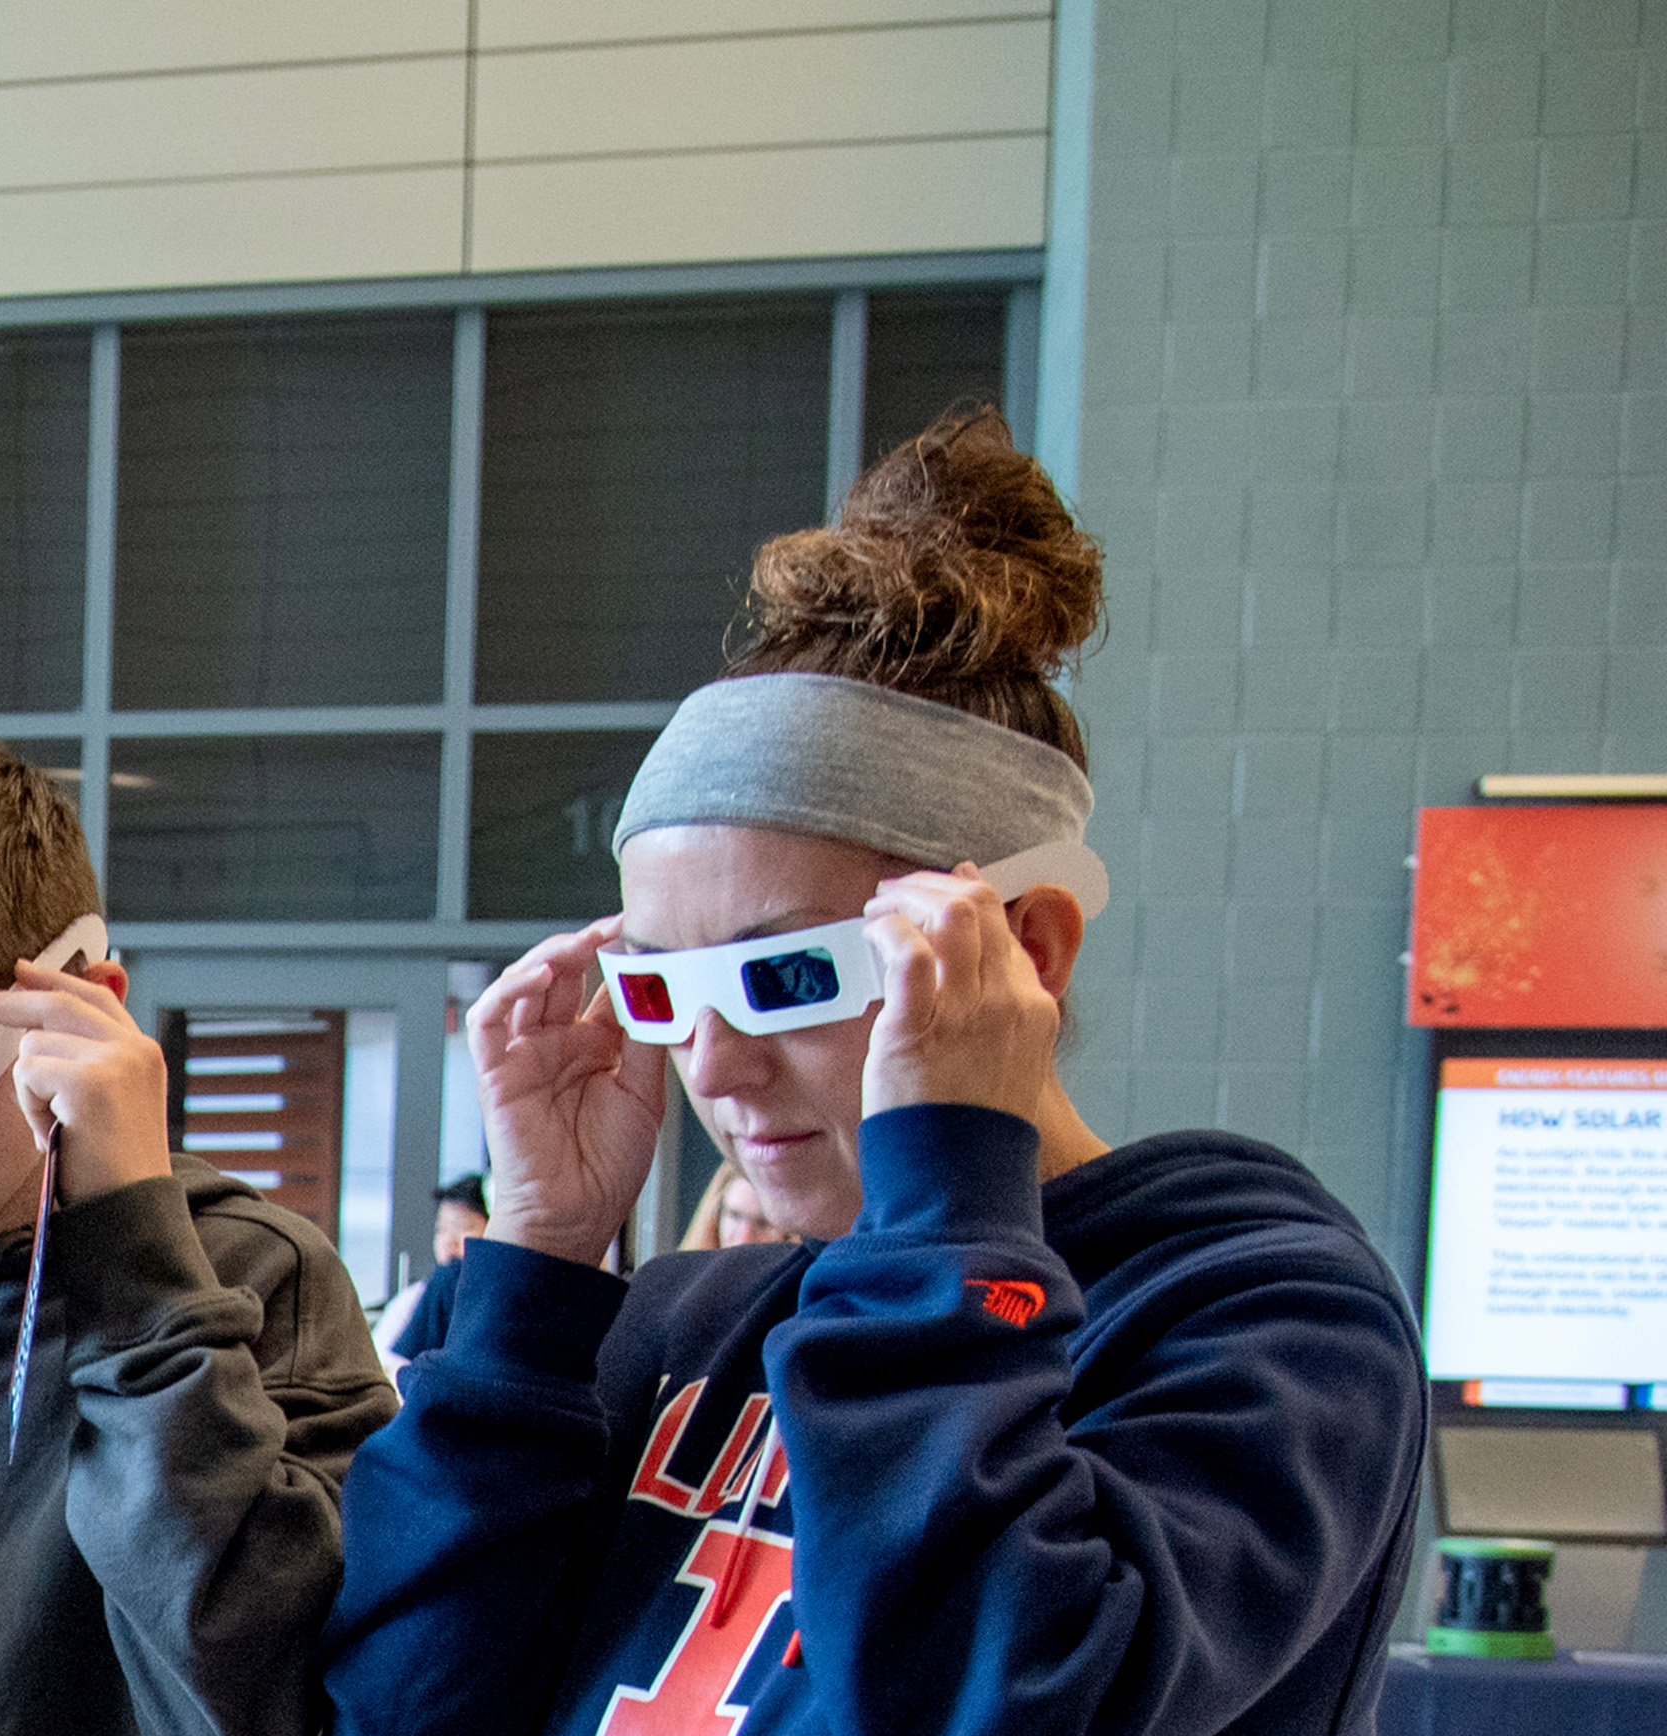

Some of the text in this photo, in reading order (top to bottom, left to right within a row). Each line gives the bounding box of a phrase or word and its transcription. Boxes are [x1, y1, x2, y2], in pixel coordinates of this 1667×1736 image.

[1496, 1068, 1560, 1085] ENERGY
[1566, 1069, 1649, 1087] FEATURES
[1499, 1109, 1662, 1128] HOW SOLAR
